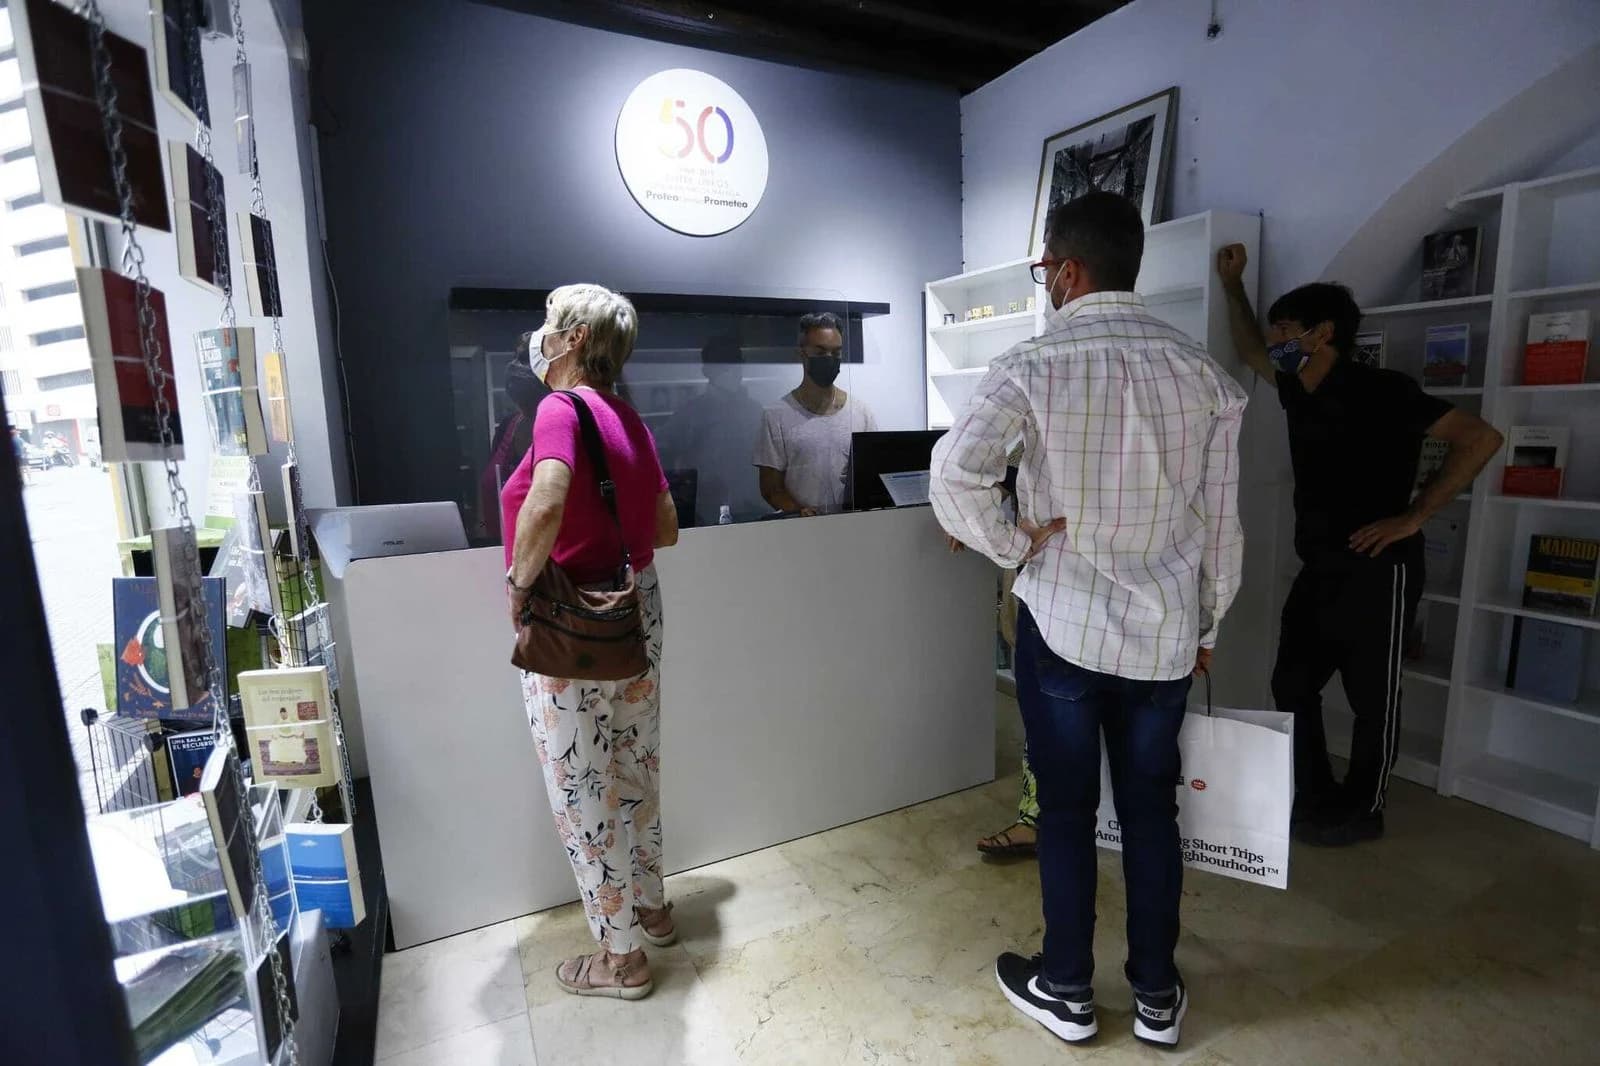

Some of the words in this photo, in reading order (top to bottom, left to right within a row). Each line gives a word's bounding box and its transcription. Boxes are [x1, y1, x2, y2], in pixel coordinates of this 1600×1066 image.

[657, 98, 735, 164] 50
[646, 190, 679, 202] Proteo
[704, 195, 748, 209] Prometeo
[182, 740, 214, 749] RECUERD
[1191, 838, 1227, 855] Short
[1229, 846, 1264, 863] Trips
[1141, 1006, 1165, 1019] NIKE
